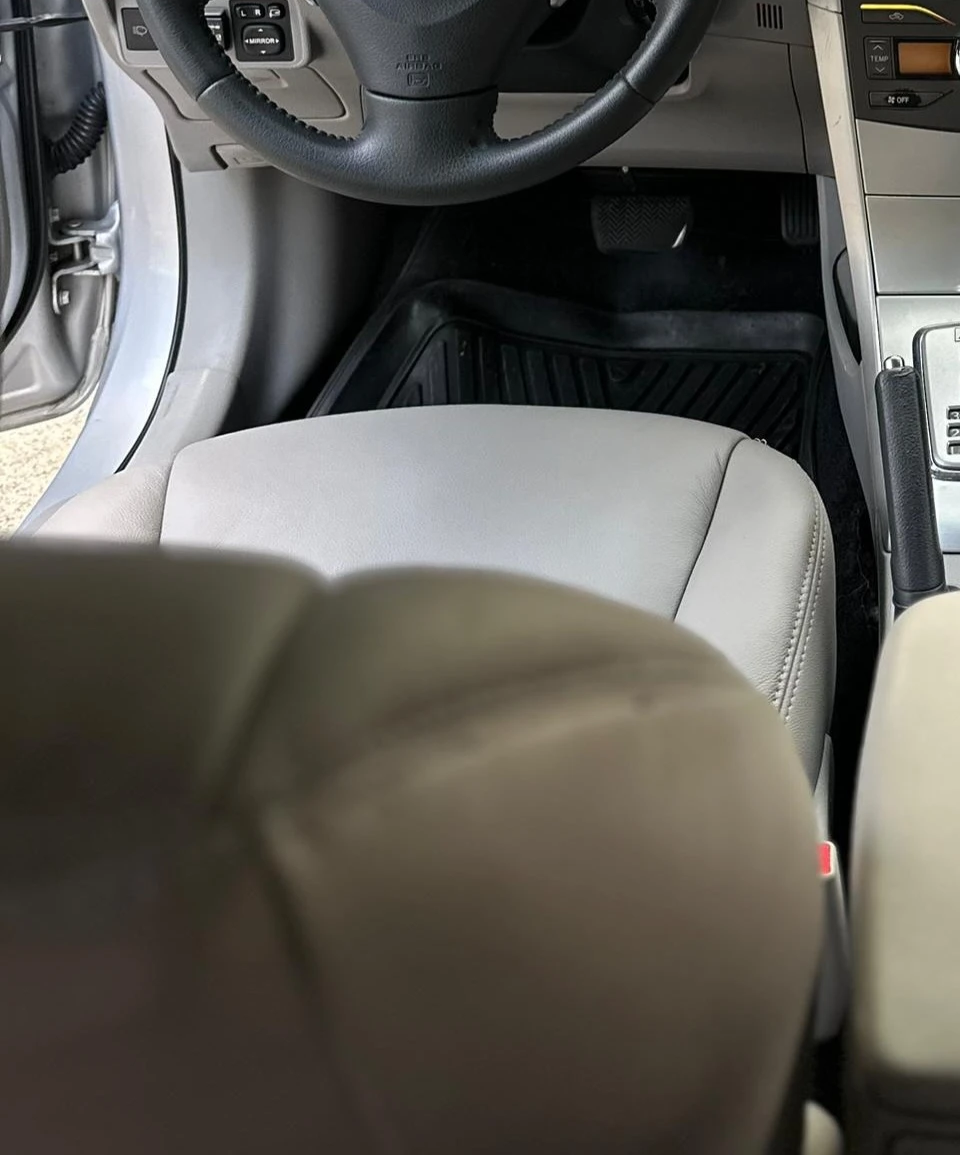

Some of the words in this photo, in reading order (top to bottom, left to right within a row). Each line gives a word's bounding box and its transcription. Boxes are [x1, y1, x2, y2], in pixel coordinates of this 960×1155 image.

[870, 54, 889, 63] TEMP
[896, 96, 910, 104] OFF
[951, 428, 960, 437] 2
